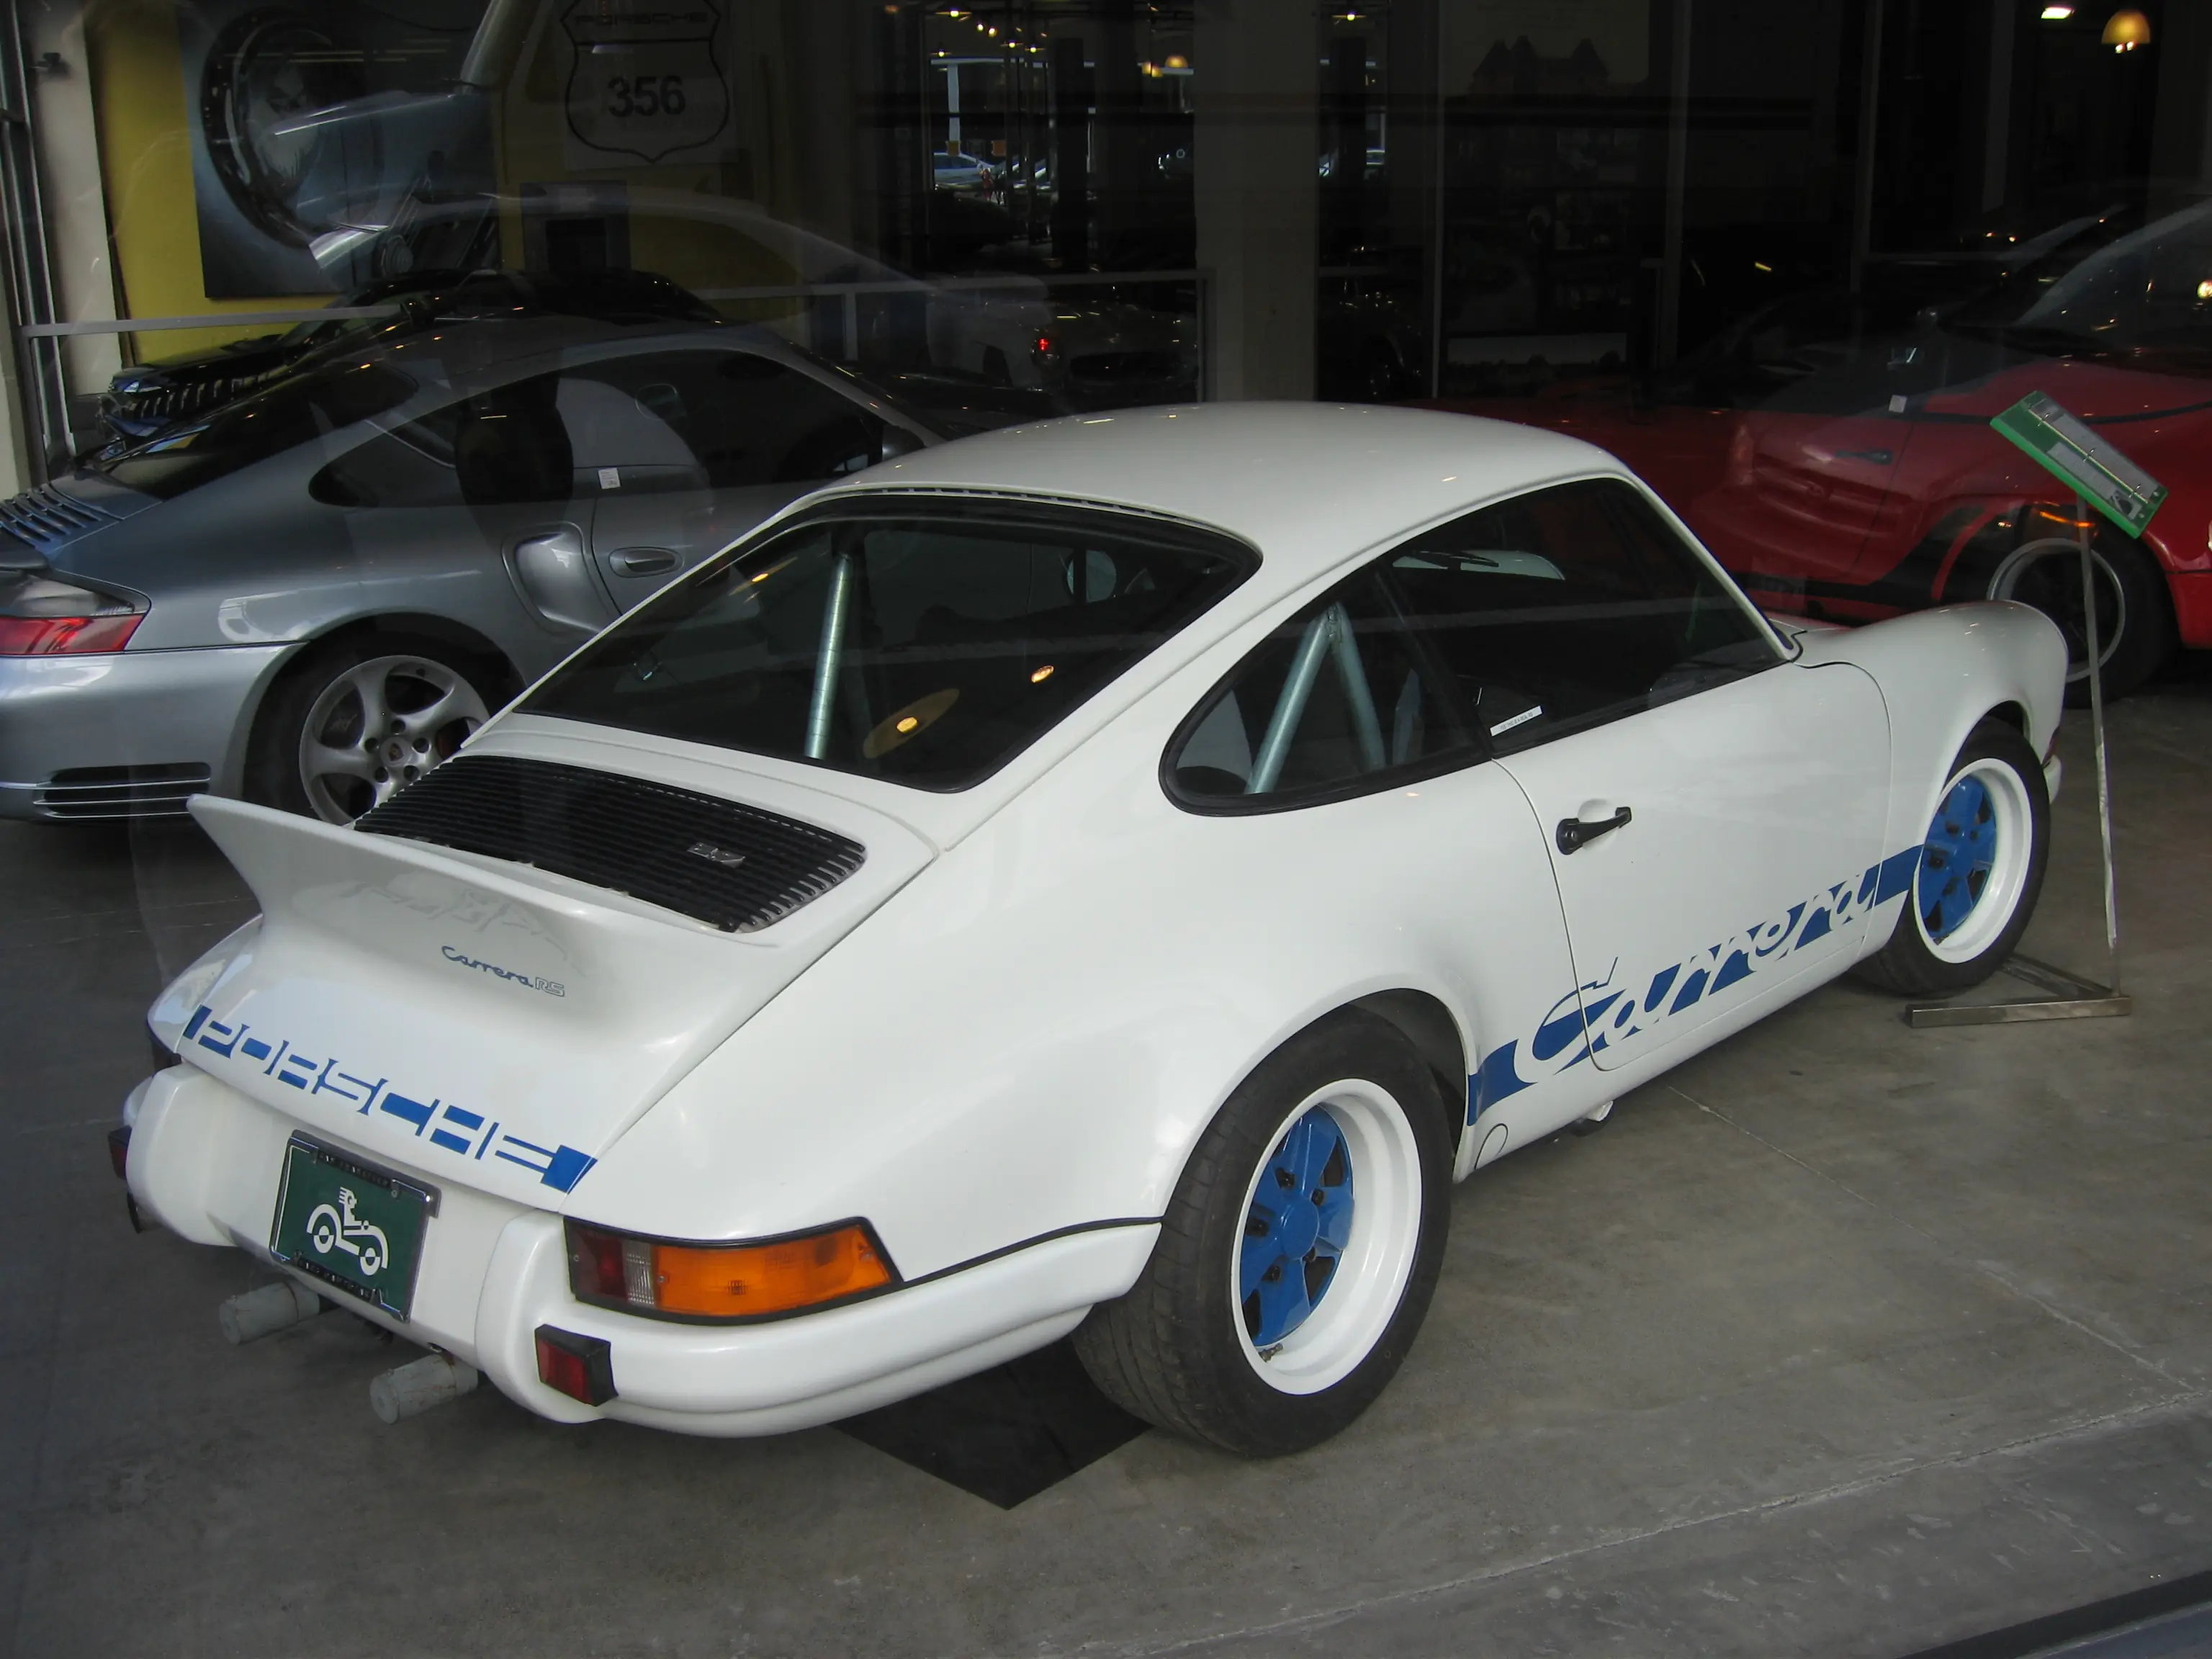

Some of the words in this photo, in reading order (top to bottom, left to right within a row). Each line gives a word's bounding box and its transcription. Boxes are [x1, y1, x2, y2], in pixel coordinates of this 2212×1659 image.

[608, 75, 685, 117] 356
[441, 945, 534, 988] Carrera
[535, 976, 565, 997] RS
[1509, 870, 1881, 1086] Carrera
[184, 1005, 590, 1192] PORSCHE
